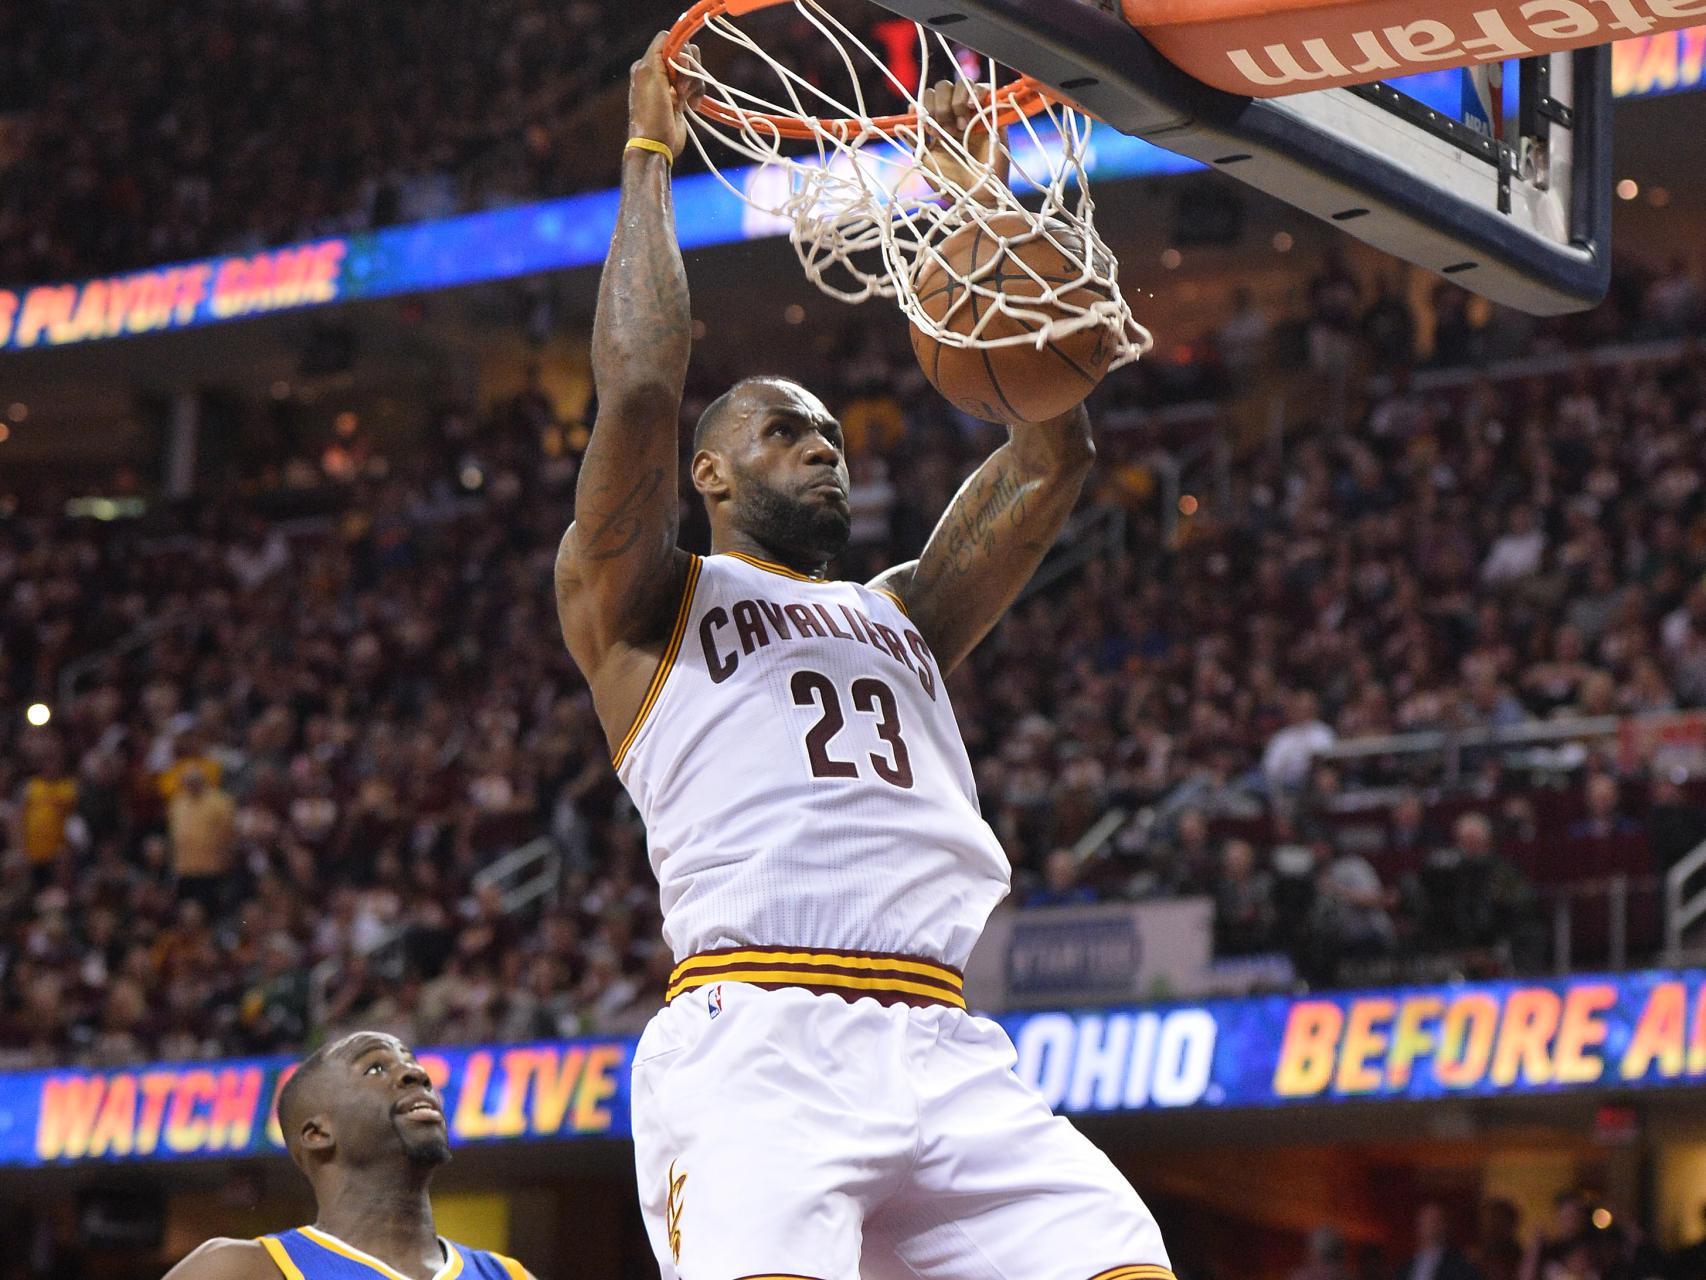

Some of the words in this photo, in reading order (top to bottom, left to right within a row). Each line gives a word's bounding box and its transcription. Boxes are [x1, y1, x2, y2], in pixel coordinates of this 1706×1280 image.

[15, 264, 212, 348] PLAYOFF
[211, 239, 346, 319] GAME
[659, 599, 936, 702] CAVALIERS
[790, 669, 914, 789] 23
[452, 1043, 625, 1140] LIVE
[1273, 984, 1619, 1098] BEFORE
[1621, 980, 1706, 1081] A
[36, 1066, 262, 1160] WATCH
